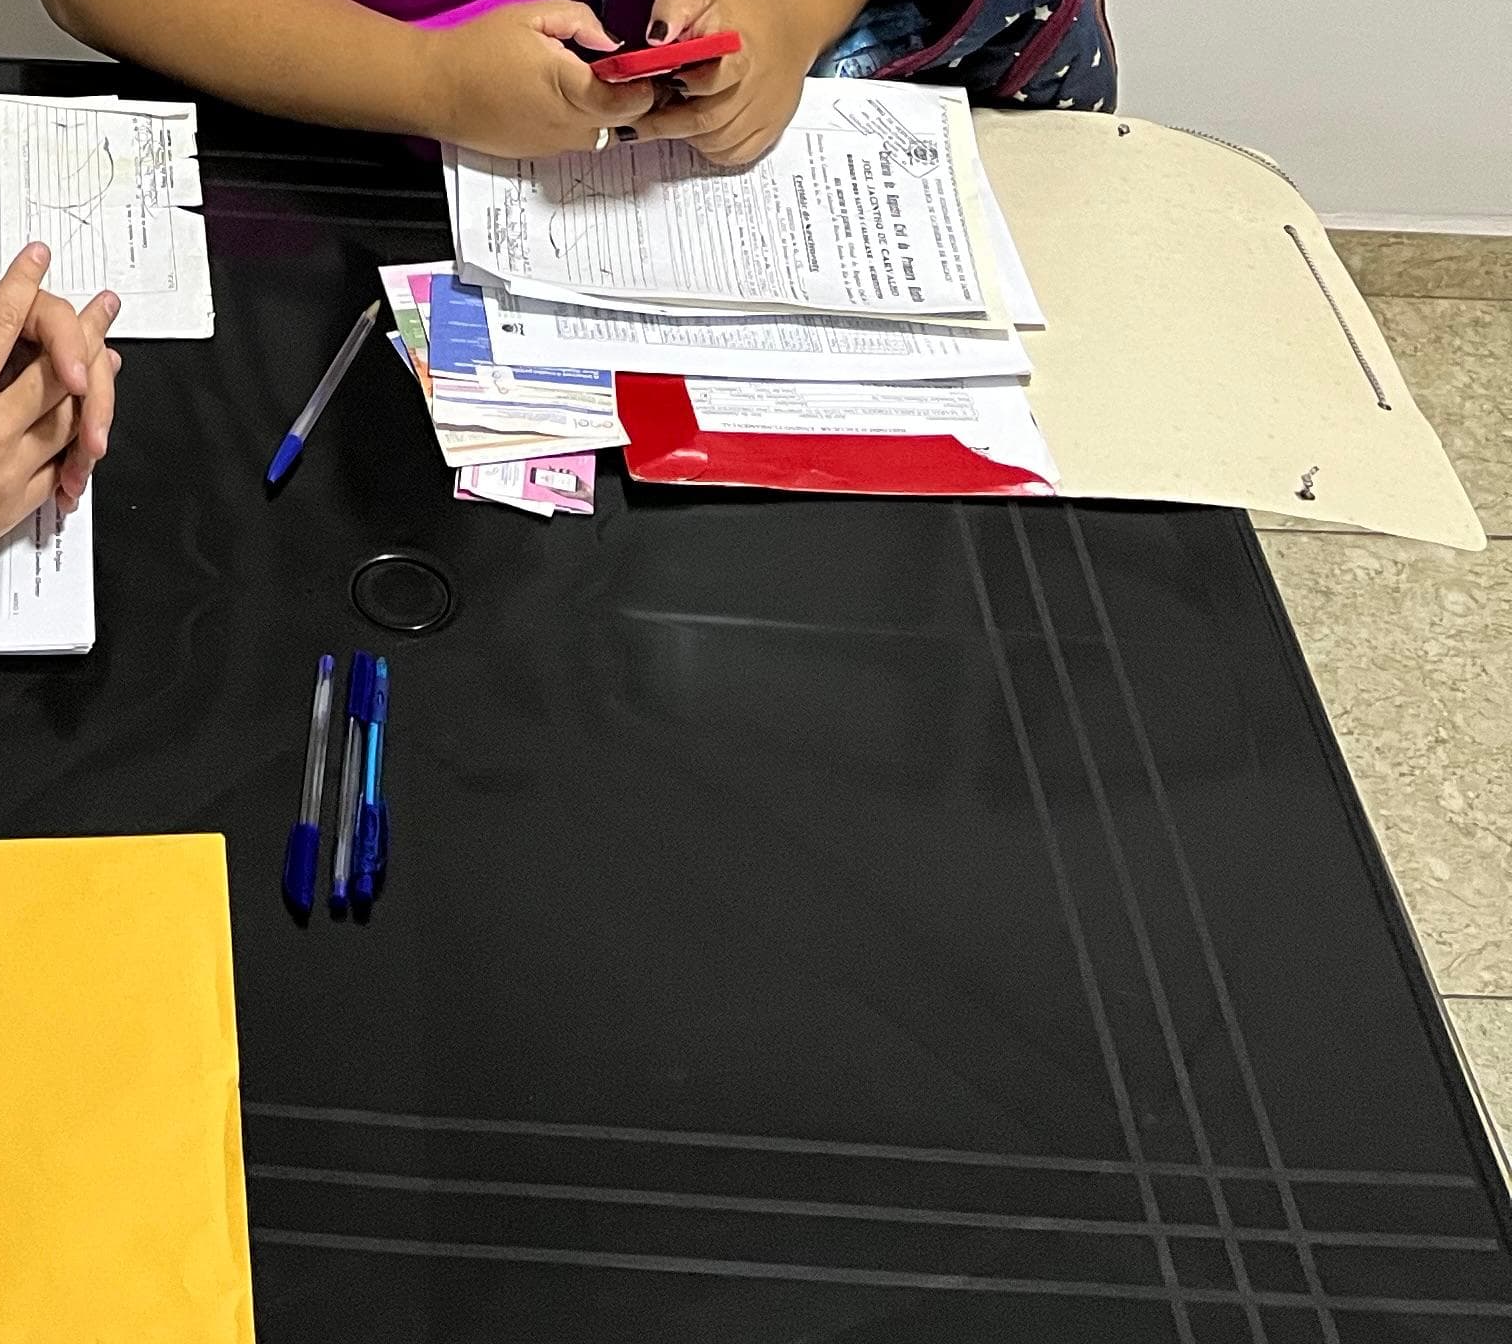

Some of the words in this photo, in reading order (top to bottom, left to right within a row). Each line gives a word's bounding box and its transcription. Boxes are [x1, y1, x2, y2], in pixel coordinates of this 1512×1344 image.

[861, 158, 874, 182] JOEL
[877, 231, 888, 246] DE
[880, 247, 900, 298] CARVALHO
